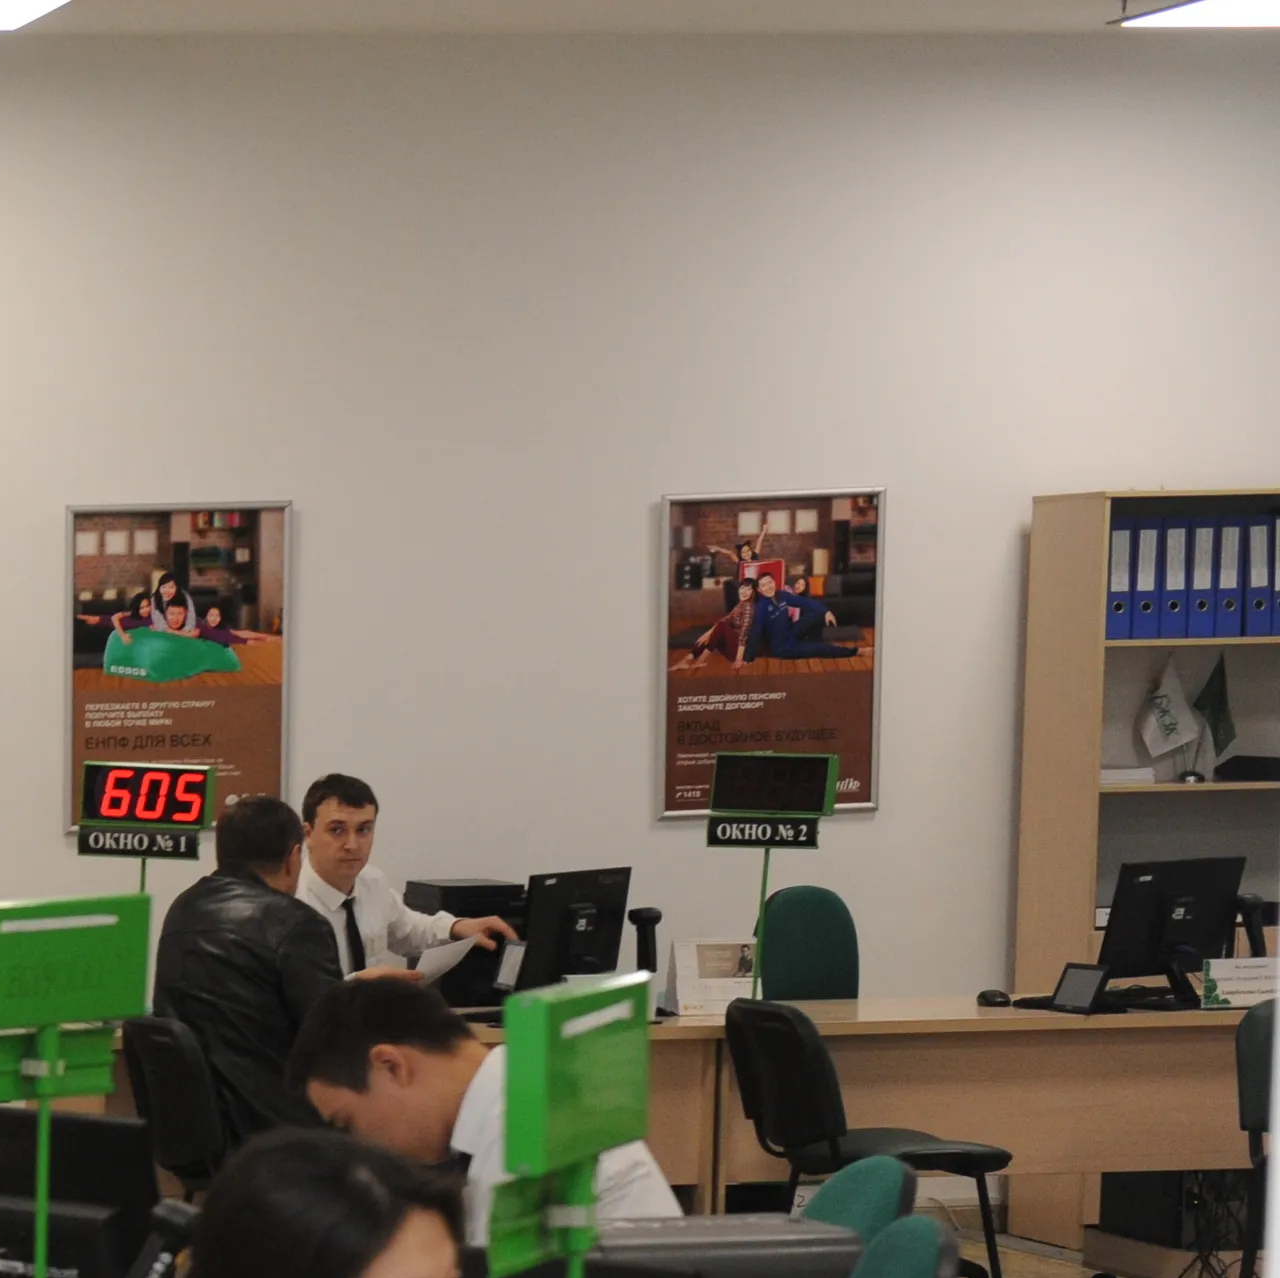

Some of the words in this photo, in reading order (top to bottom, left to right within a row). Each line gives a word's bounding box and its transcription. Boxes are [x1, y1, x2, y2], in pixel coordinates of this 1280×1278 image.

[85, 735, 130, 750] ЕНПФ
[132, 735, 166, 750] ДЛЯ
[170, 733, 213, 748] ВСЕХ
[100, 769, 205, 822] 605
[88, 831, 149, 852] ОКНО
[152, 834, 174, 852] №
[179, 835, 188, 852] 1
[716, 823, 772, 841] ОКНО
[775, 823, 794, 841] №
[798, 824, 808, 841] 2
